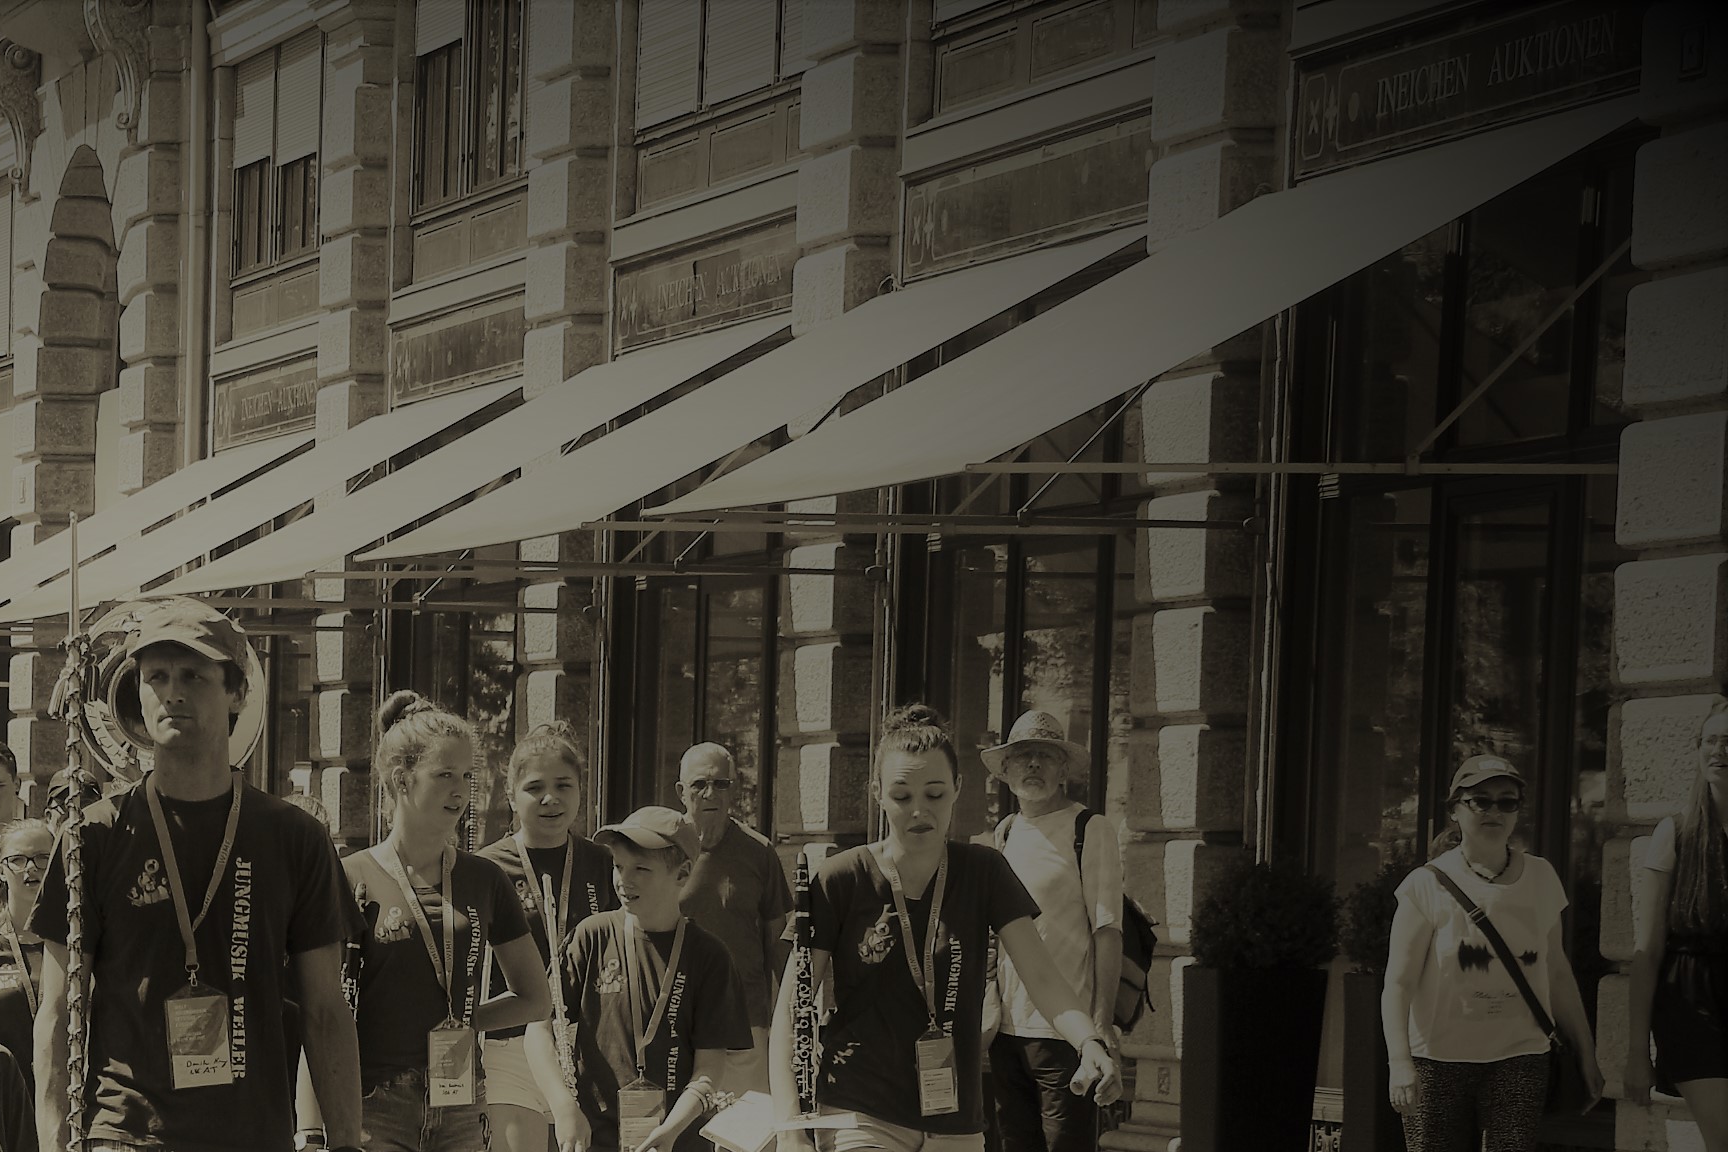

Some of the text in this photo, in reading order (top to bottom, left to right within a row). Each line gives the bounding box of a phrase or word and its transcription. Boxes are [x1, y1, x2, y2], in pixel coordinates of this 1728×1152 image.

[1376, 11, 1617, 119] INEICHEN AUKTIONEN
[218, 839, 232, 865] WJMF
[231, 856, 252, 1079] JUNGMUSIK WEILER
[427, 943, 439, 963] WJMF
[466, 905, 481, 977] JUNGMUSIK
[943, 936, 962, 1012] JUNGMUSIK
[667, 1046, 679, 1091] WEILER
